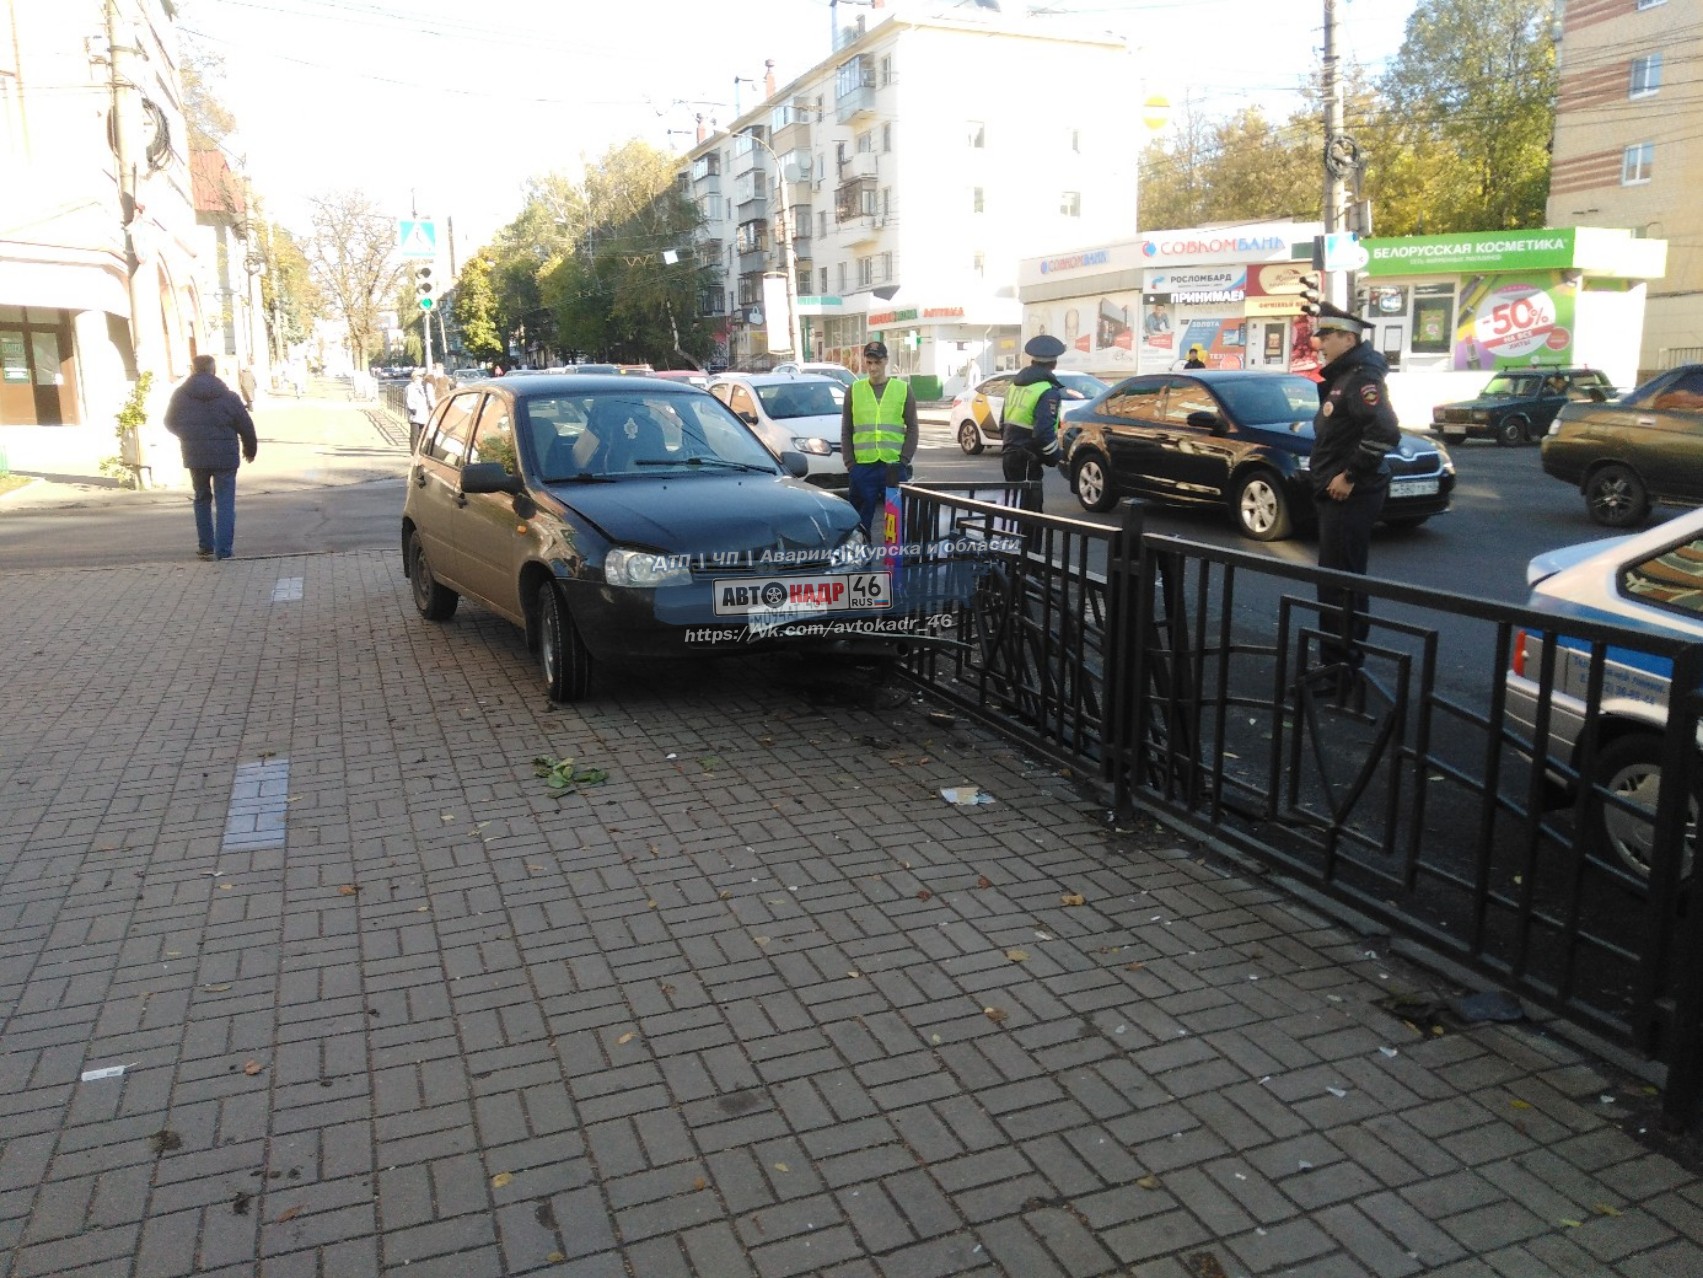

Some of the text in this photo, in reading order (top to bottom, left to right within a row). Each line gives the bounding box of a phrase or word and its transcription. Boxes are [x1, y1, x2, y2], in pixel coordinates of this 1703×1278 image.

[1160, 237, 1285, 255] СОВКОМБАНК
[1373, 238, 1564, 259] БЕЛОРУССКАЯ КОСМЕТИКА
[1170, 273, 1232, 284] РОСЛОМБАРД
[1483, 298, 1549, 335] -50%
